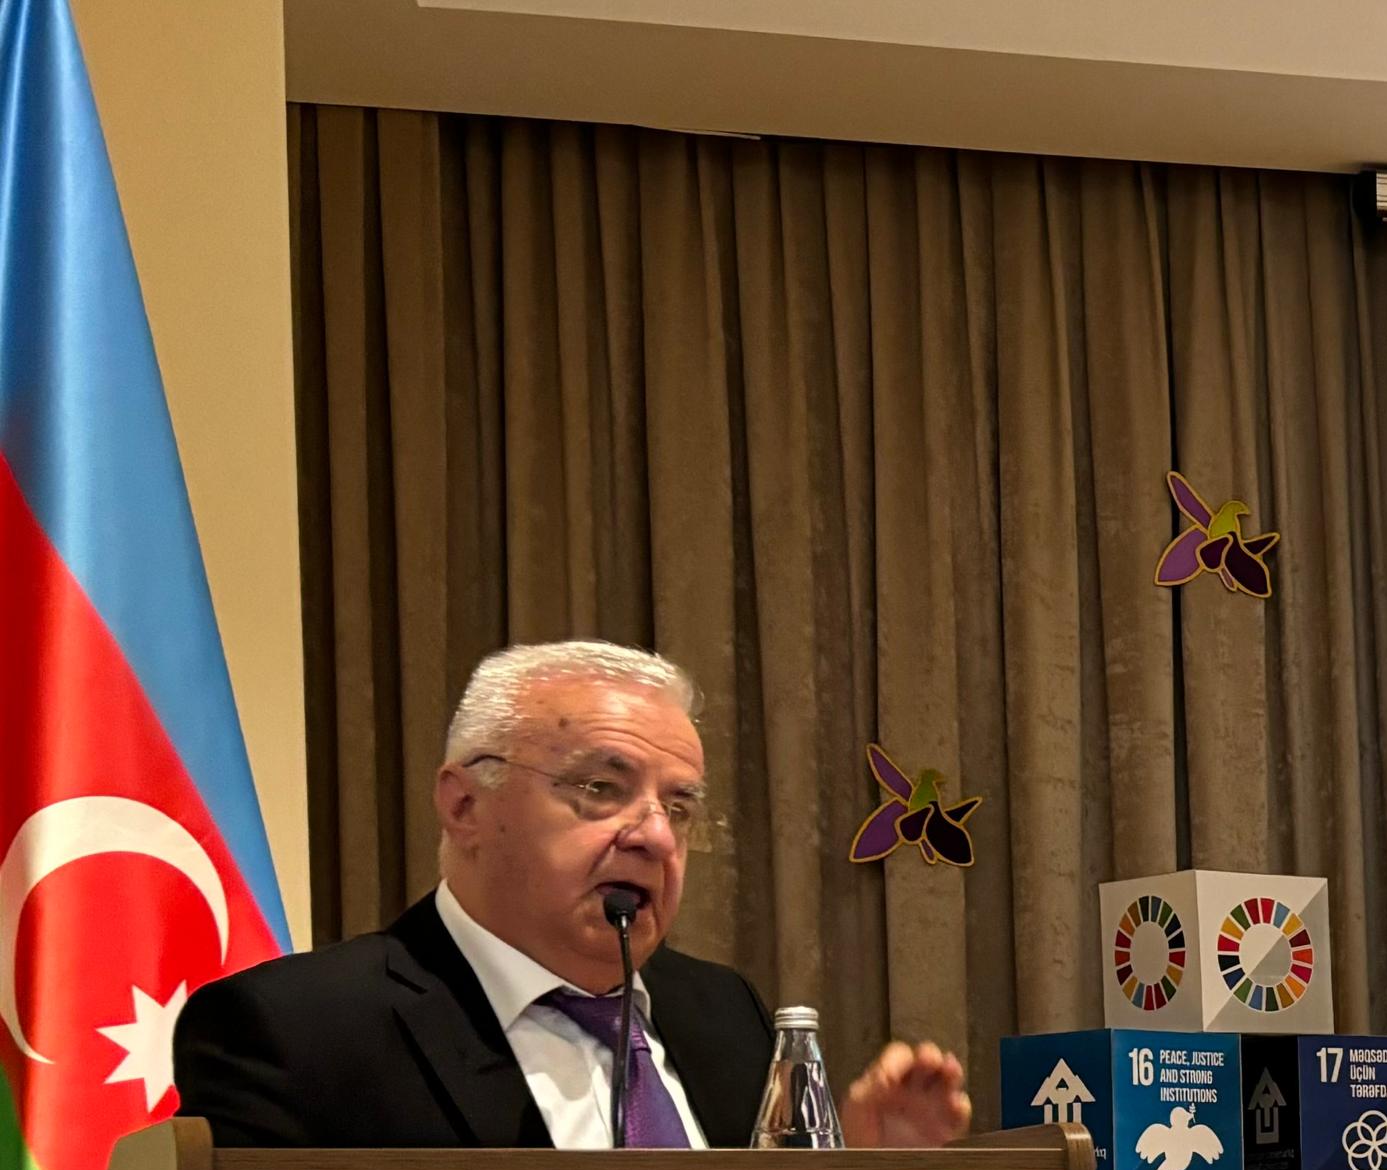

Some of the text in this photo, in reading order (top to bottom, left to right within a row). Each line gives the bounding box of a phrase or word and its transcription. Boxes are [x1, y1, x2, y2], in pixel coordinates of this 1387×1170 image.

[1160, 1050, 1224, 1066] PEACE, JUSTICE
[1316, 1047, 1343, 1083] 17
[1128, 1048, 1154, 1086] 16
[1350, 1064, 1375, 1083] ÜÇÜN
[1160, 1069, 1213, 1084] AND STRONG
[1160, 1087, 1217, 1103] INSTITUTIONS
